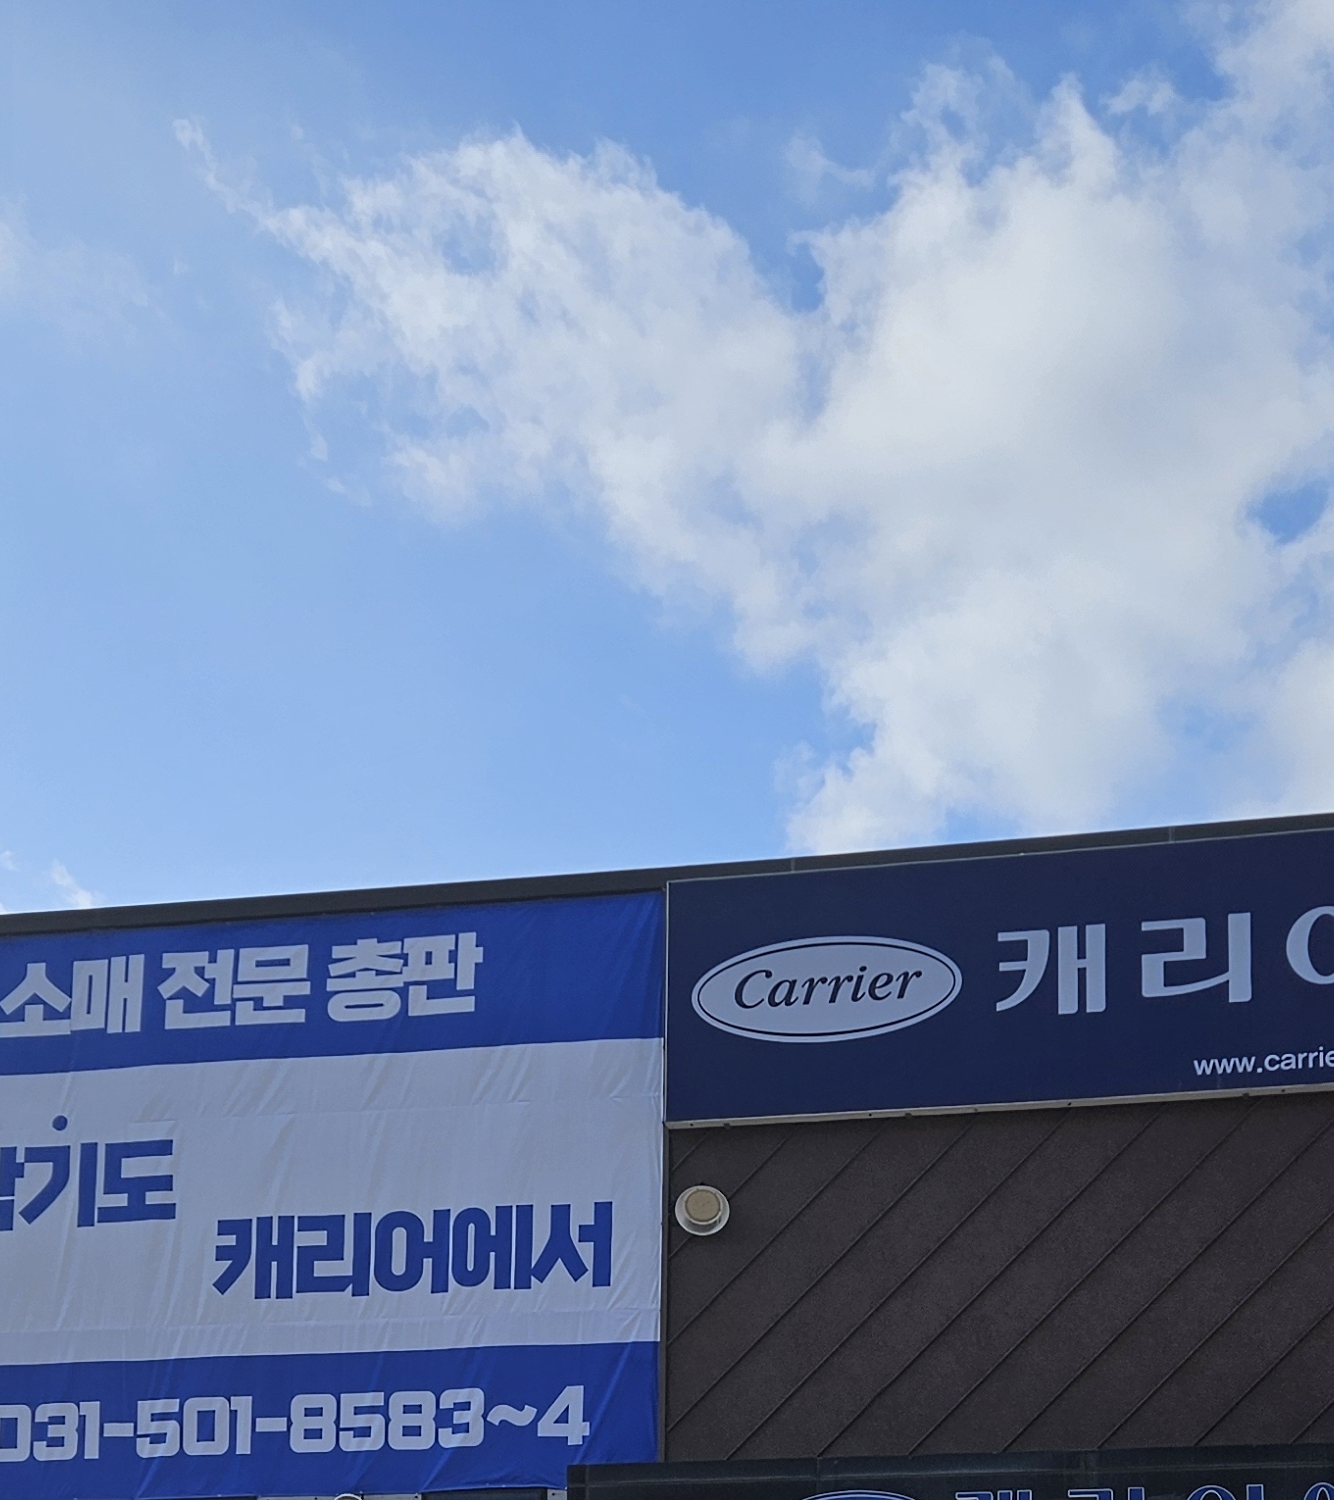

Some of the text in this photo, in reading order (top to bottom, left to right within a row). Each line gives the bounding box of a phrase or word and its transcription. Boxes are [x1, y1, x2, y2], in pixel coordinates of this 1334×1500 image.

[158, 946, 310, 1031] 전문
[327, 932, 482, 1023] 총판
[733, 964, 923, 1011] Carrier
[212, 1202, 613, 1300] 캐리어에서
